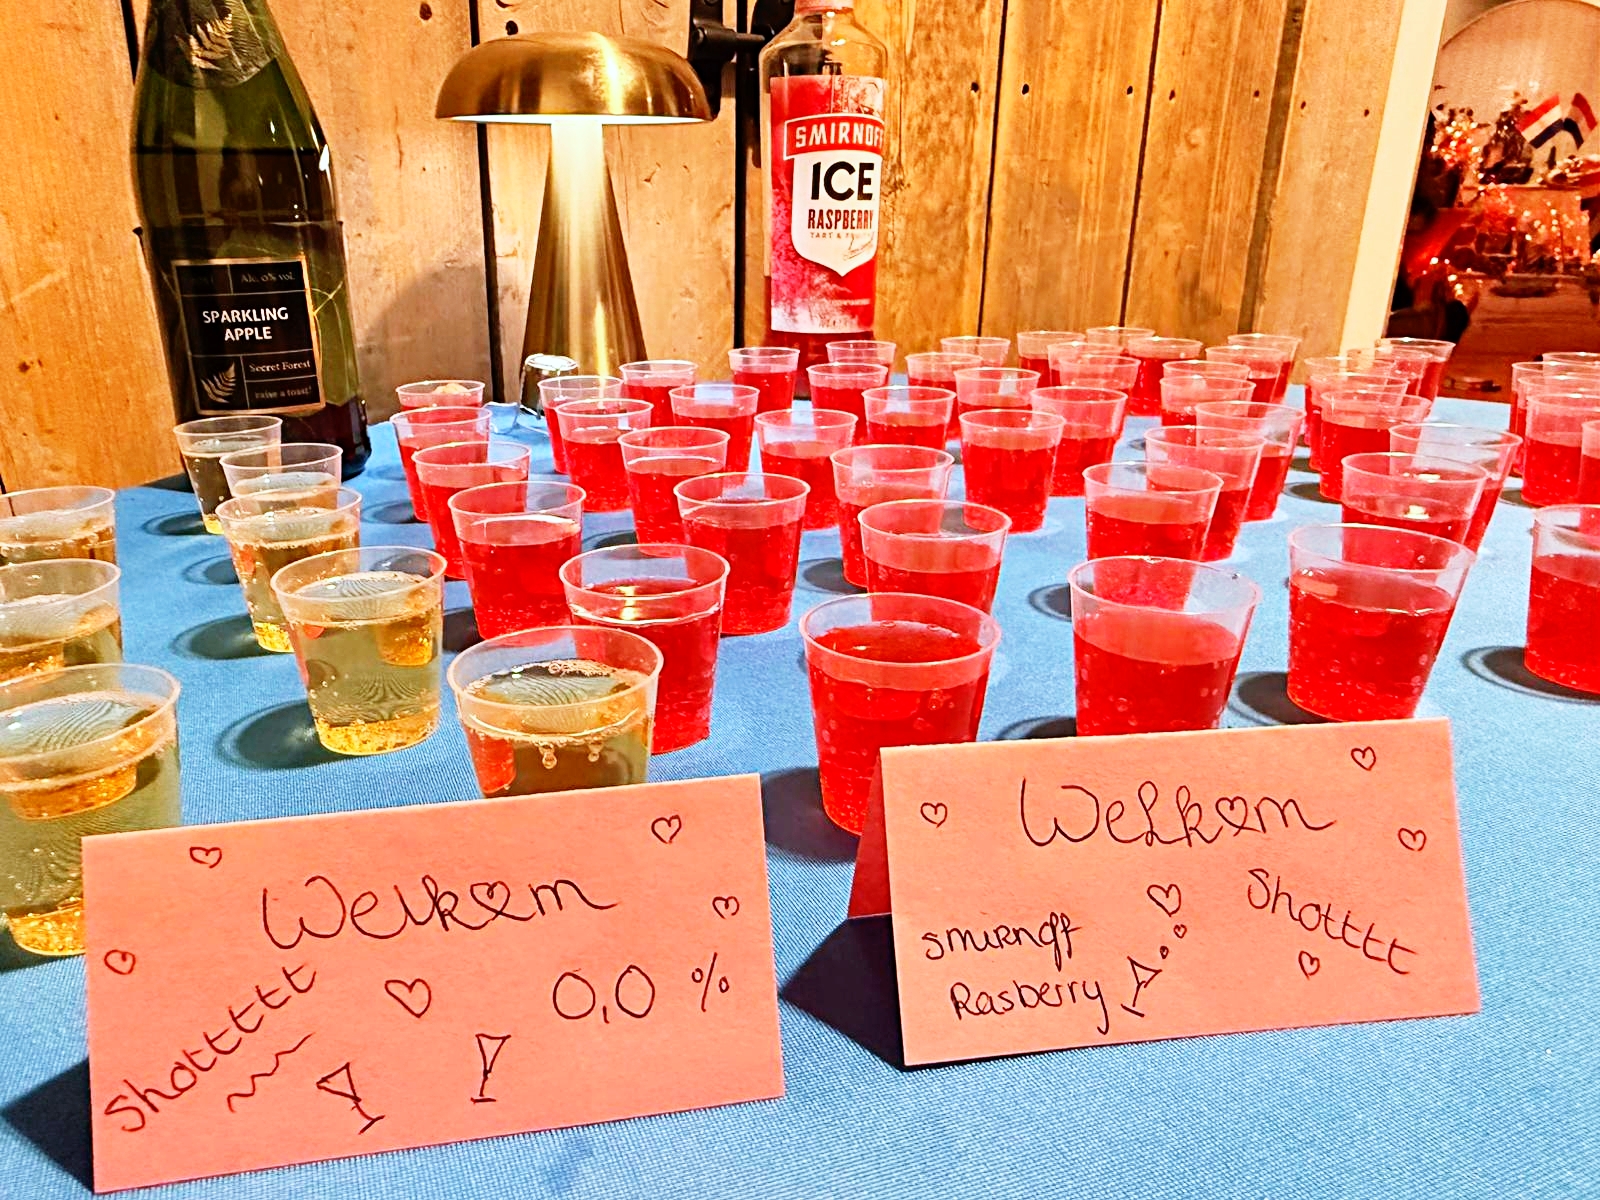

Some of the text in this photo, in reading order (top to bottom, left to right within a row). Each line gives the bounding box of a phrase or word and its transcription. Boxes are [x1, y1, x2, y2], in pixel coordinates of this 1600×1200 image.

[810, 161, 875, 201] ICE
[807, 209, 874, 230] RASPBERRY
[810, 231, 834, 239] TART
[202, 307, 289, 324] SPARKLING
[224, 326, 273, 342] APPLE
[249, 360, 311, 373] Secret Forest
[552, 952, 730, 1024] 0,0 %
[950, 980, 1109, 1035] Rasberry
